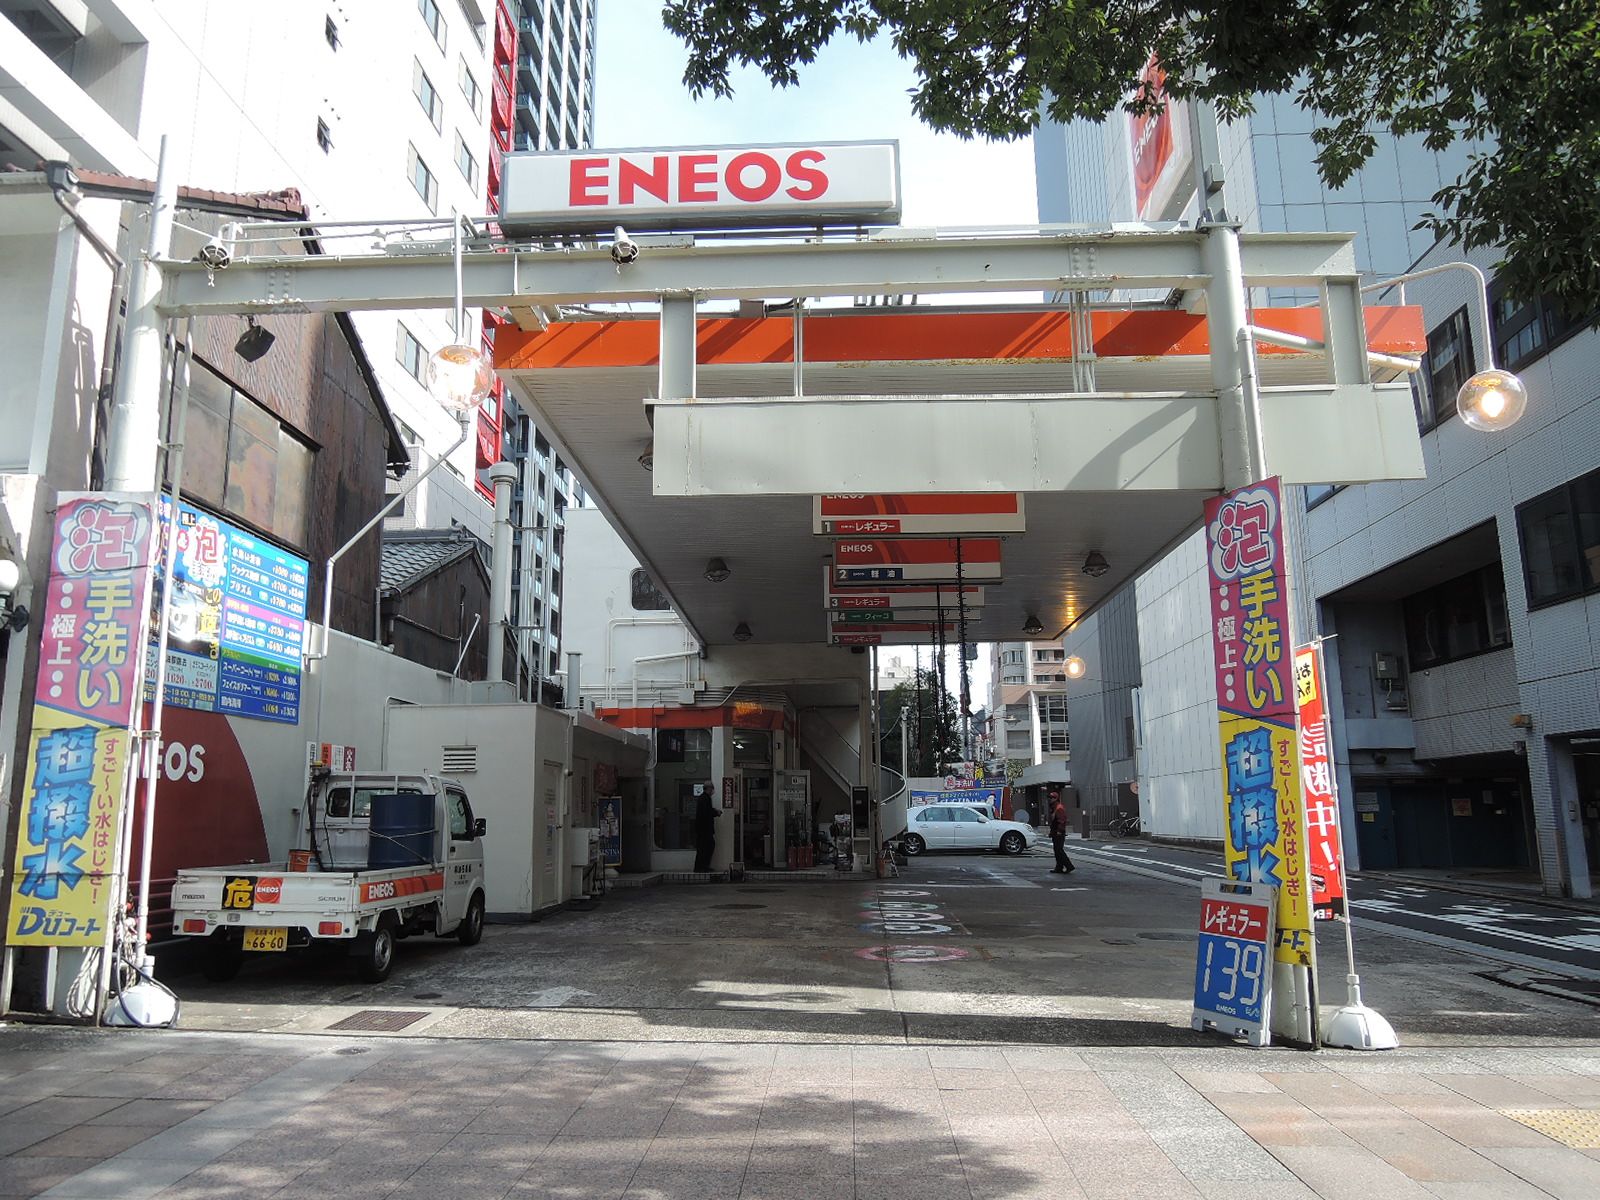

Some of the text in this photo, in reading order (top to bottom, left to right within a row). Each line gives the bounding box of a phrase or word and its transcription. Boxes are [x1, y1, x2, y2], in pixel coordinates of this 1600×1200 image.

[568, 150, 829, 207] ENEOS
[825, 522, 831, 532] 1
[856, 522, 895, 531] レギュラー
[841, 545, 873, 553] ENEOS
[839, 570, 847, 579] 2
[839, 612, 846, 620] 4
[47, 614, 77, 665] 極上
[1218, 616, 1238, 669] 極上
[18, 724, 99, 900] 超撥水
[1226, 726, 1283, 891] 超撥水
[224, 878, 254, 908] 危
[368, 882, 394, 900] ENEOS
[1205, 903, 1261, 935] レギュラー
[252, 937, 284, 949] 66-60
[1203, 940, 1263, 1006] 139
[1216, 1003, 1237, 1015] ENEOS
